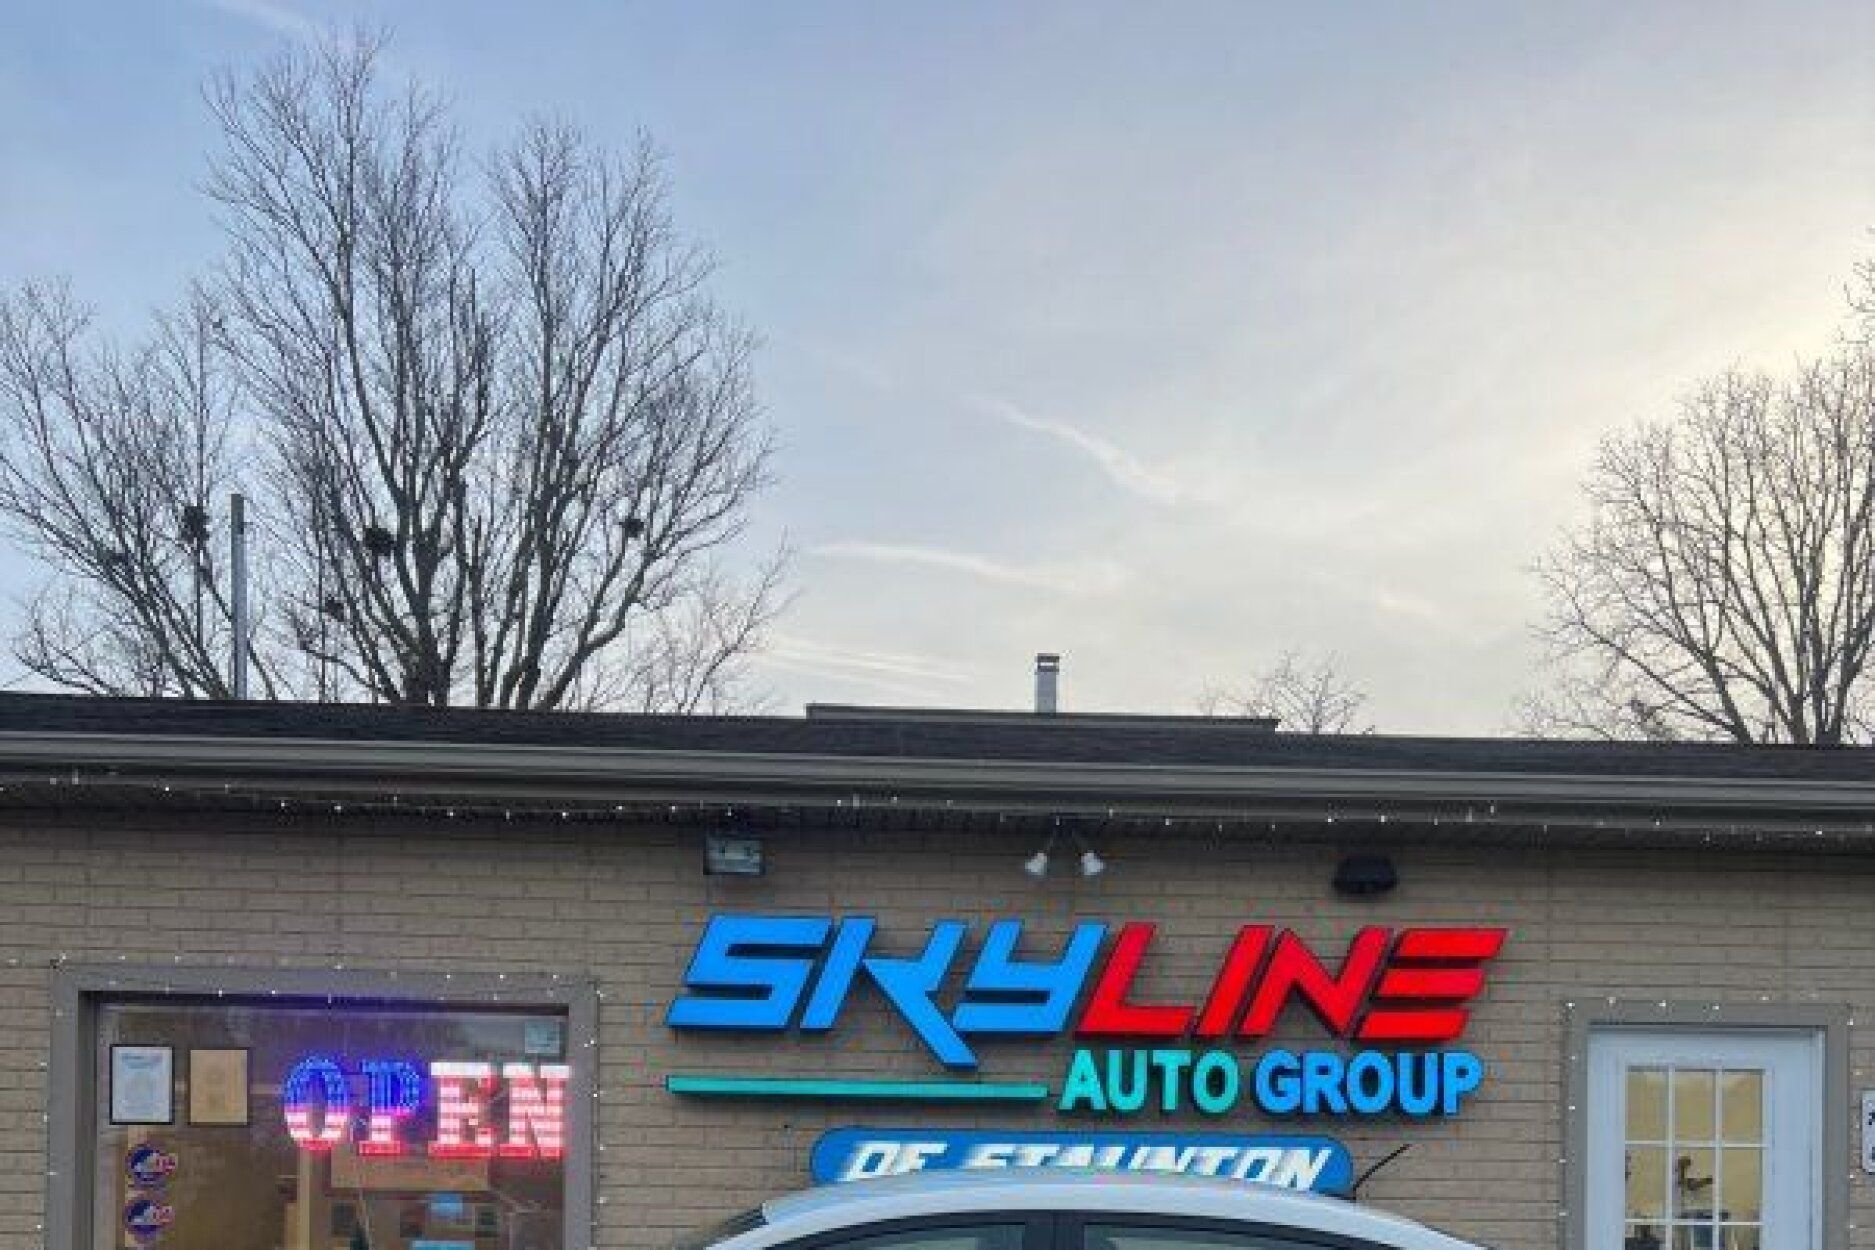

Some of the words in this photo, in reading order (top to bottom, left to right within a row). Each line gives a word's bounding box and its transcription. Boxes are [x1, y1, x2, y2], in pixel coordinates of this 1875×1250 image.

[666, 914, 1507, 1069] SKYLINE
[284, 1058, 571, 1157] OPEN
[1058, 1048, 1240, 1114] AUTO
[1255, 1049, 1483, 1116] GROUP
